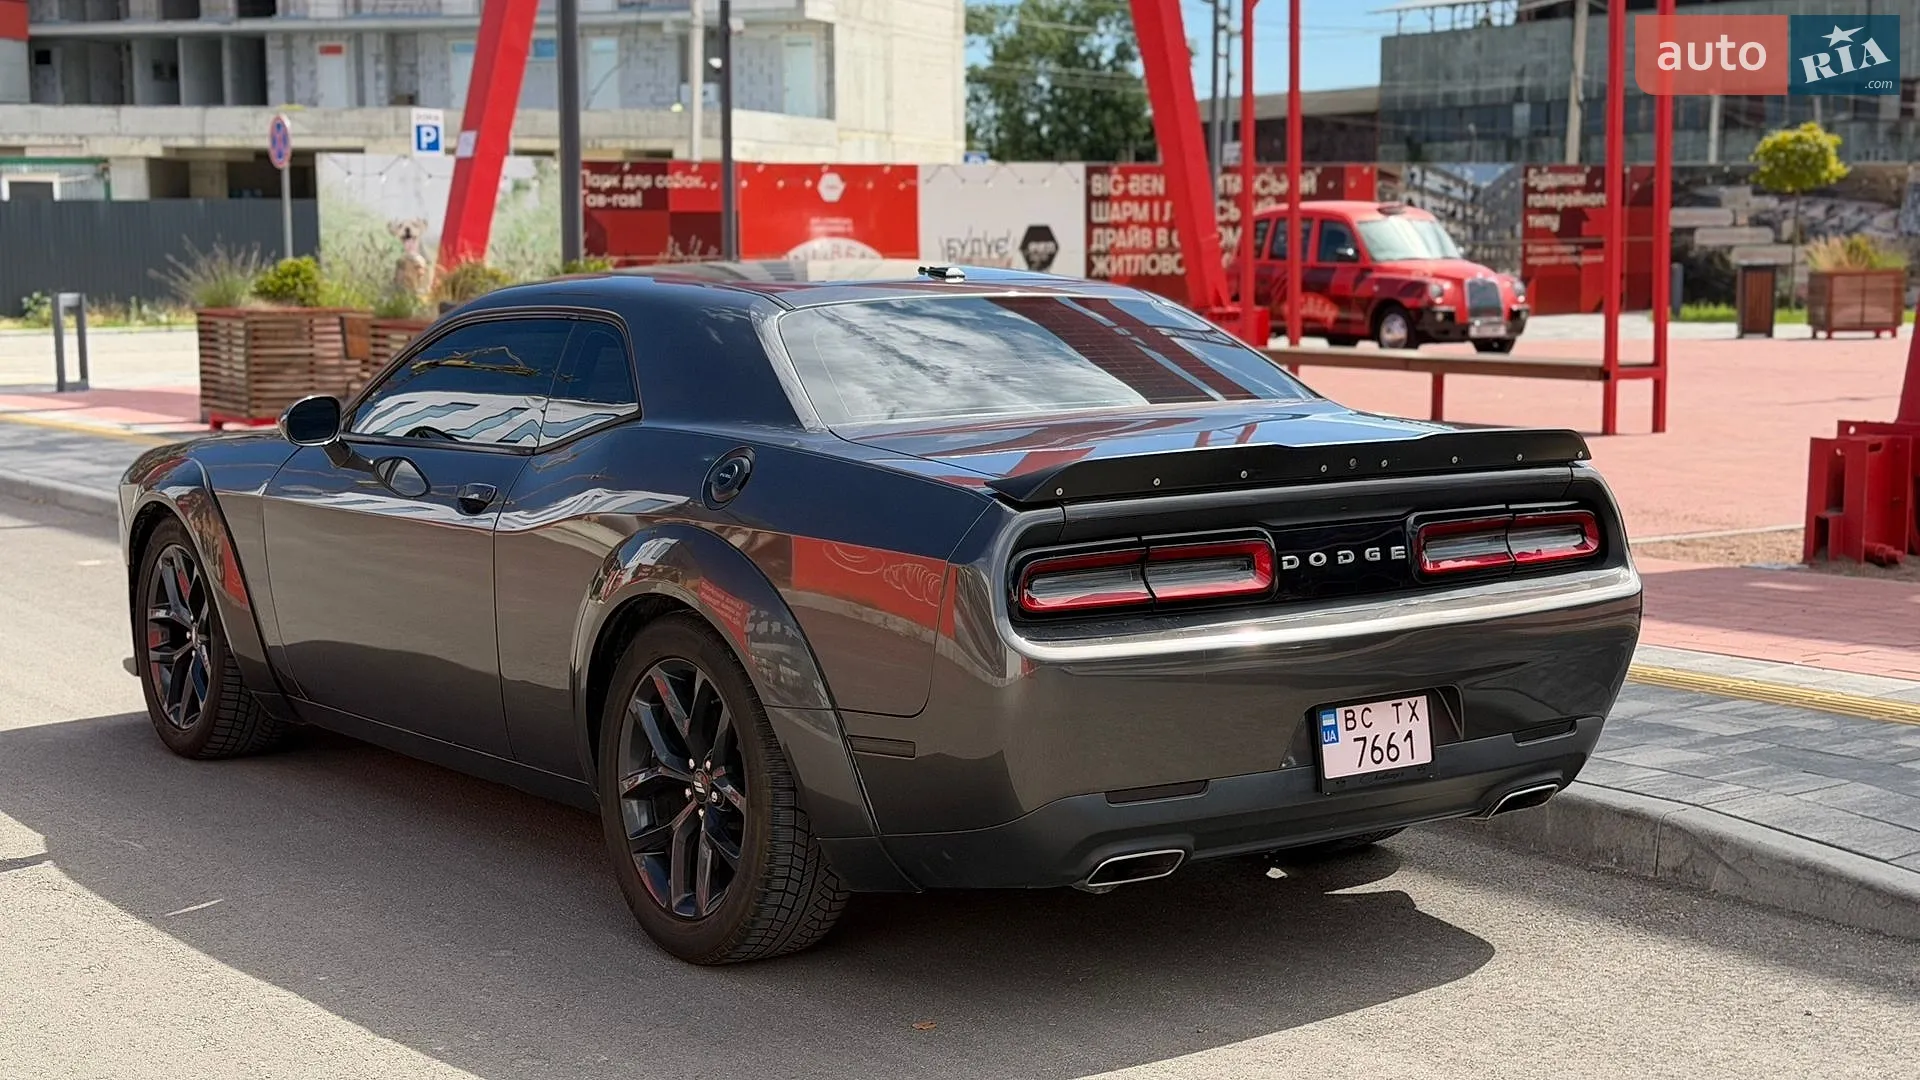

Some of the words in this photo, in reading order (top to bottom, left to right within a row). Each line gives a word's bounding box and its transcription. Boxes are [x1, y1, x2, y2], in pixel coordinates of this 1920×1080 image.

[1091, 174, 1125, 196] BIG
[1091, 200, 1150, 222] ШАРМ
[1090, 225, 1152, 251] ДРАЙВ
[1156, 227, 1167, 248] В
[1090, 253, 1186, 277] ЖИТЛОВО
[1281, 545, 1406, 570] DODGE
[1344, 707, 1373, 731] BC
[1391, 700, 1420, 724] TX
[1323, 730, 1337, 743] UA
[1353, 729, 1415, 768] 7661
